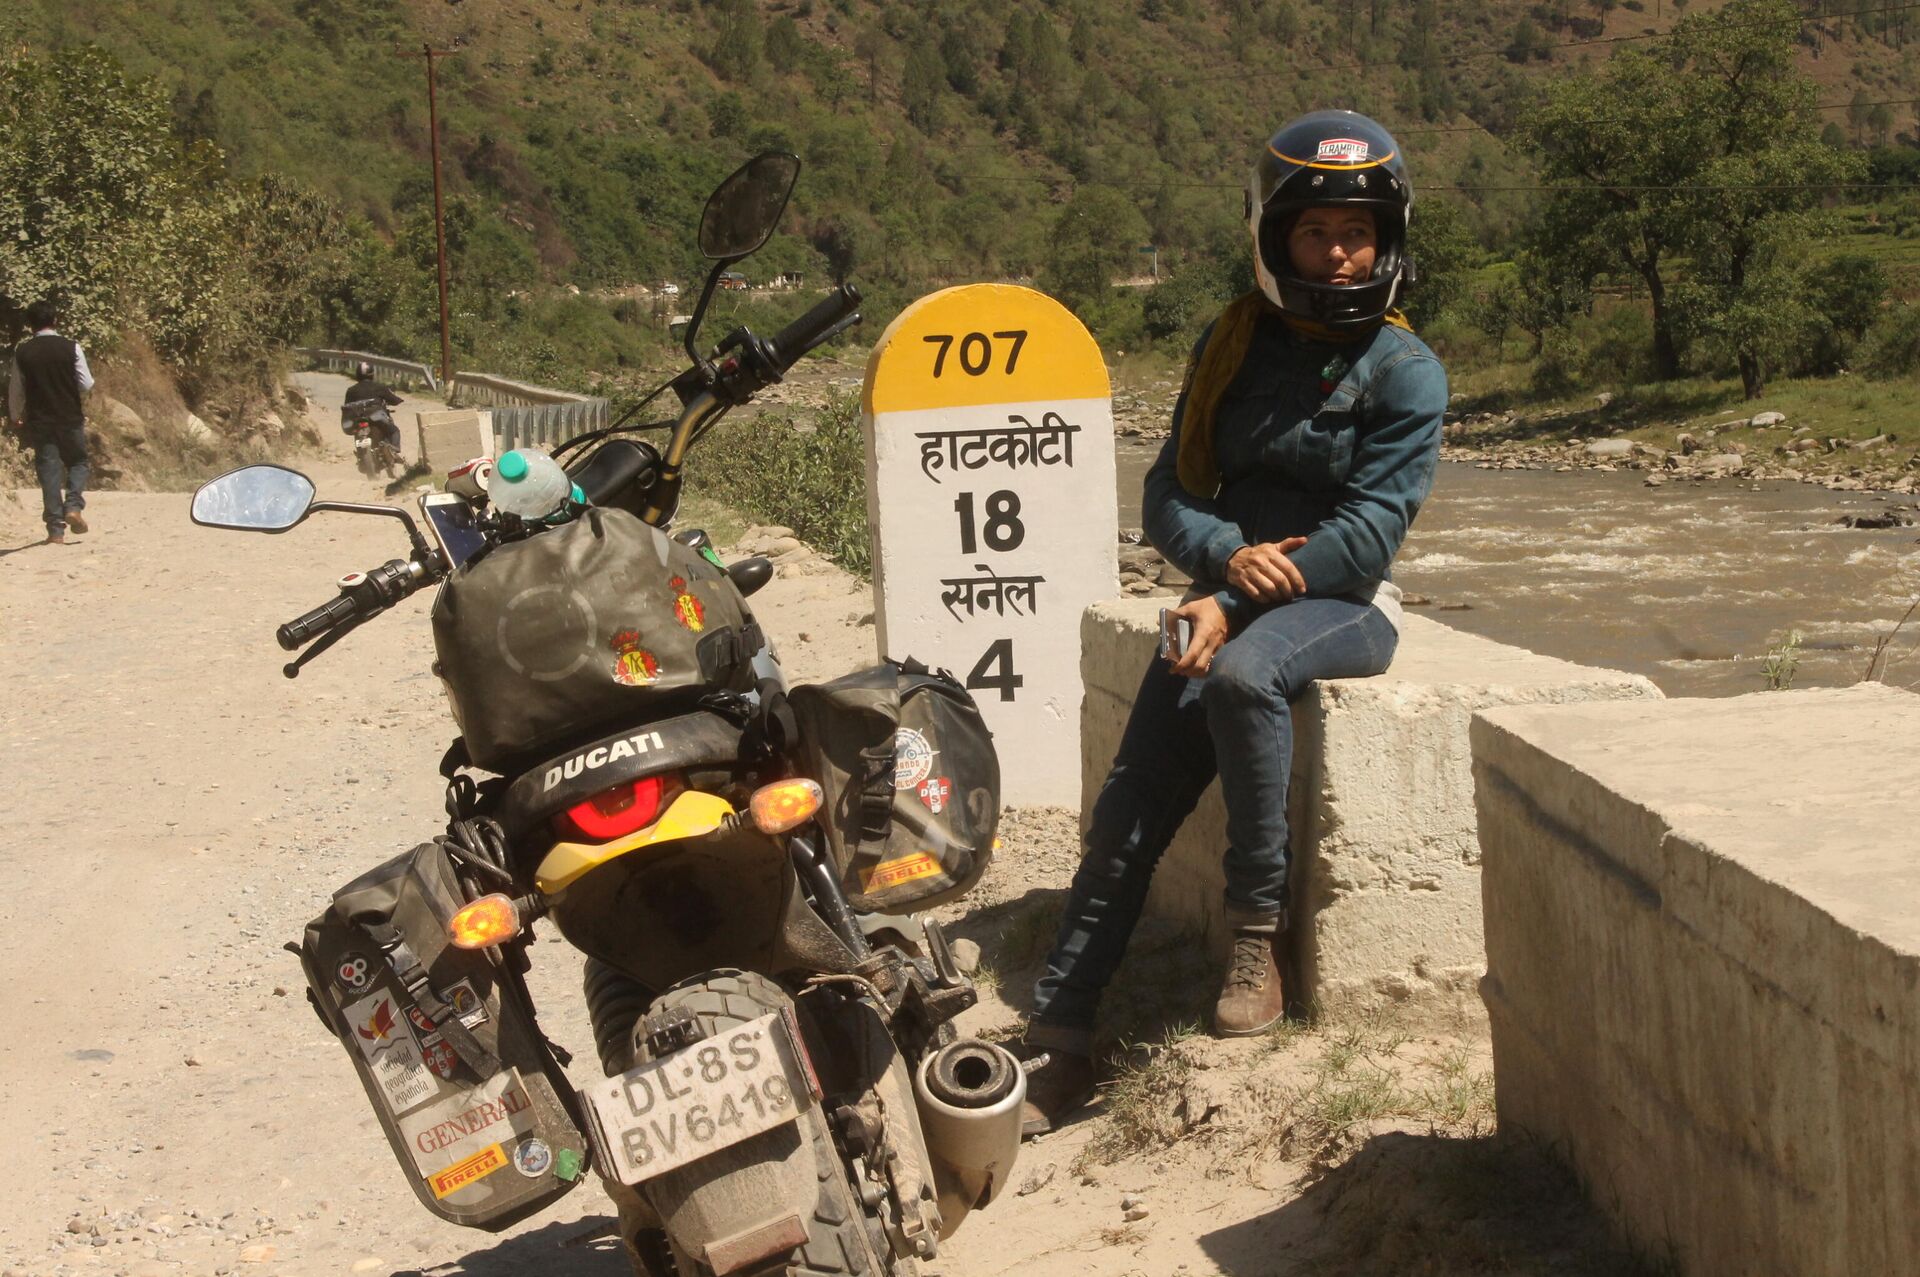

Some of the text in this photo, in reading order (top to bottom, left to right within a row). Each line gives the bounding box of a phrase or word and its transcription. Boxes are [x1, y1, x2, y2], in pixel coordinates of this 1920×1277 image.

[922, 329, 1028, 379] 707
[914, 411, 1081, 484] हाटकोटी
[954, 489, 1025, 555] 18
[940, 564, 1046, 623] सनेल
[965, 638, 1024, 702] 4
[543, 731, 664, 792] DUCATI
[865, 856, 932, 887] PIRELLI
[621, 1074, 793, 1169] BV6419
[435, 1149, 499, 1193] PIRELLI
